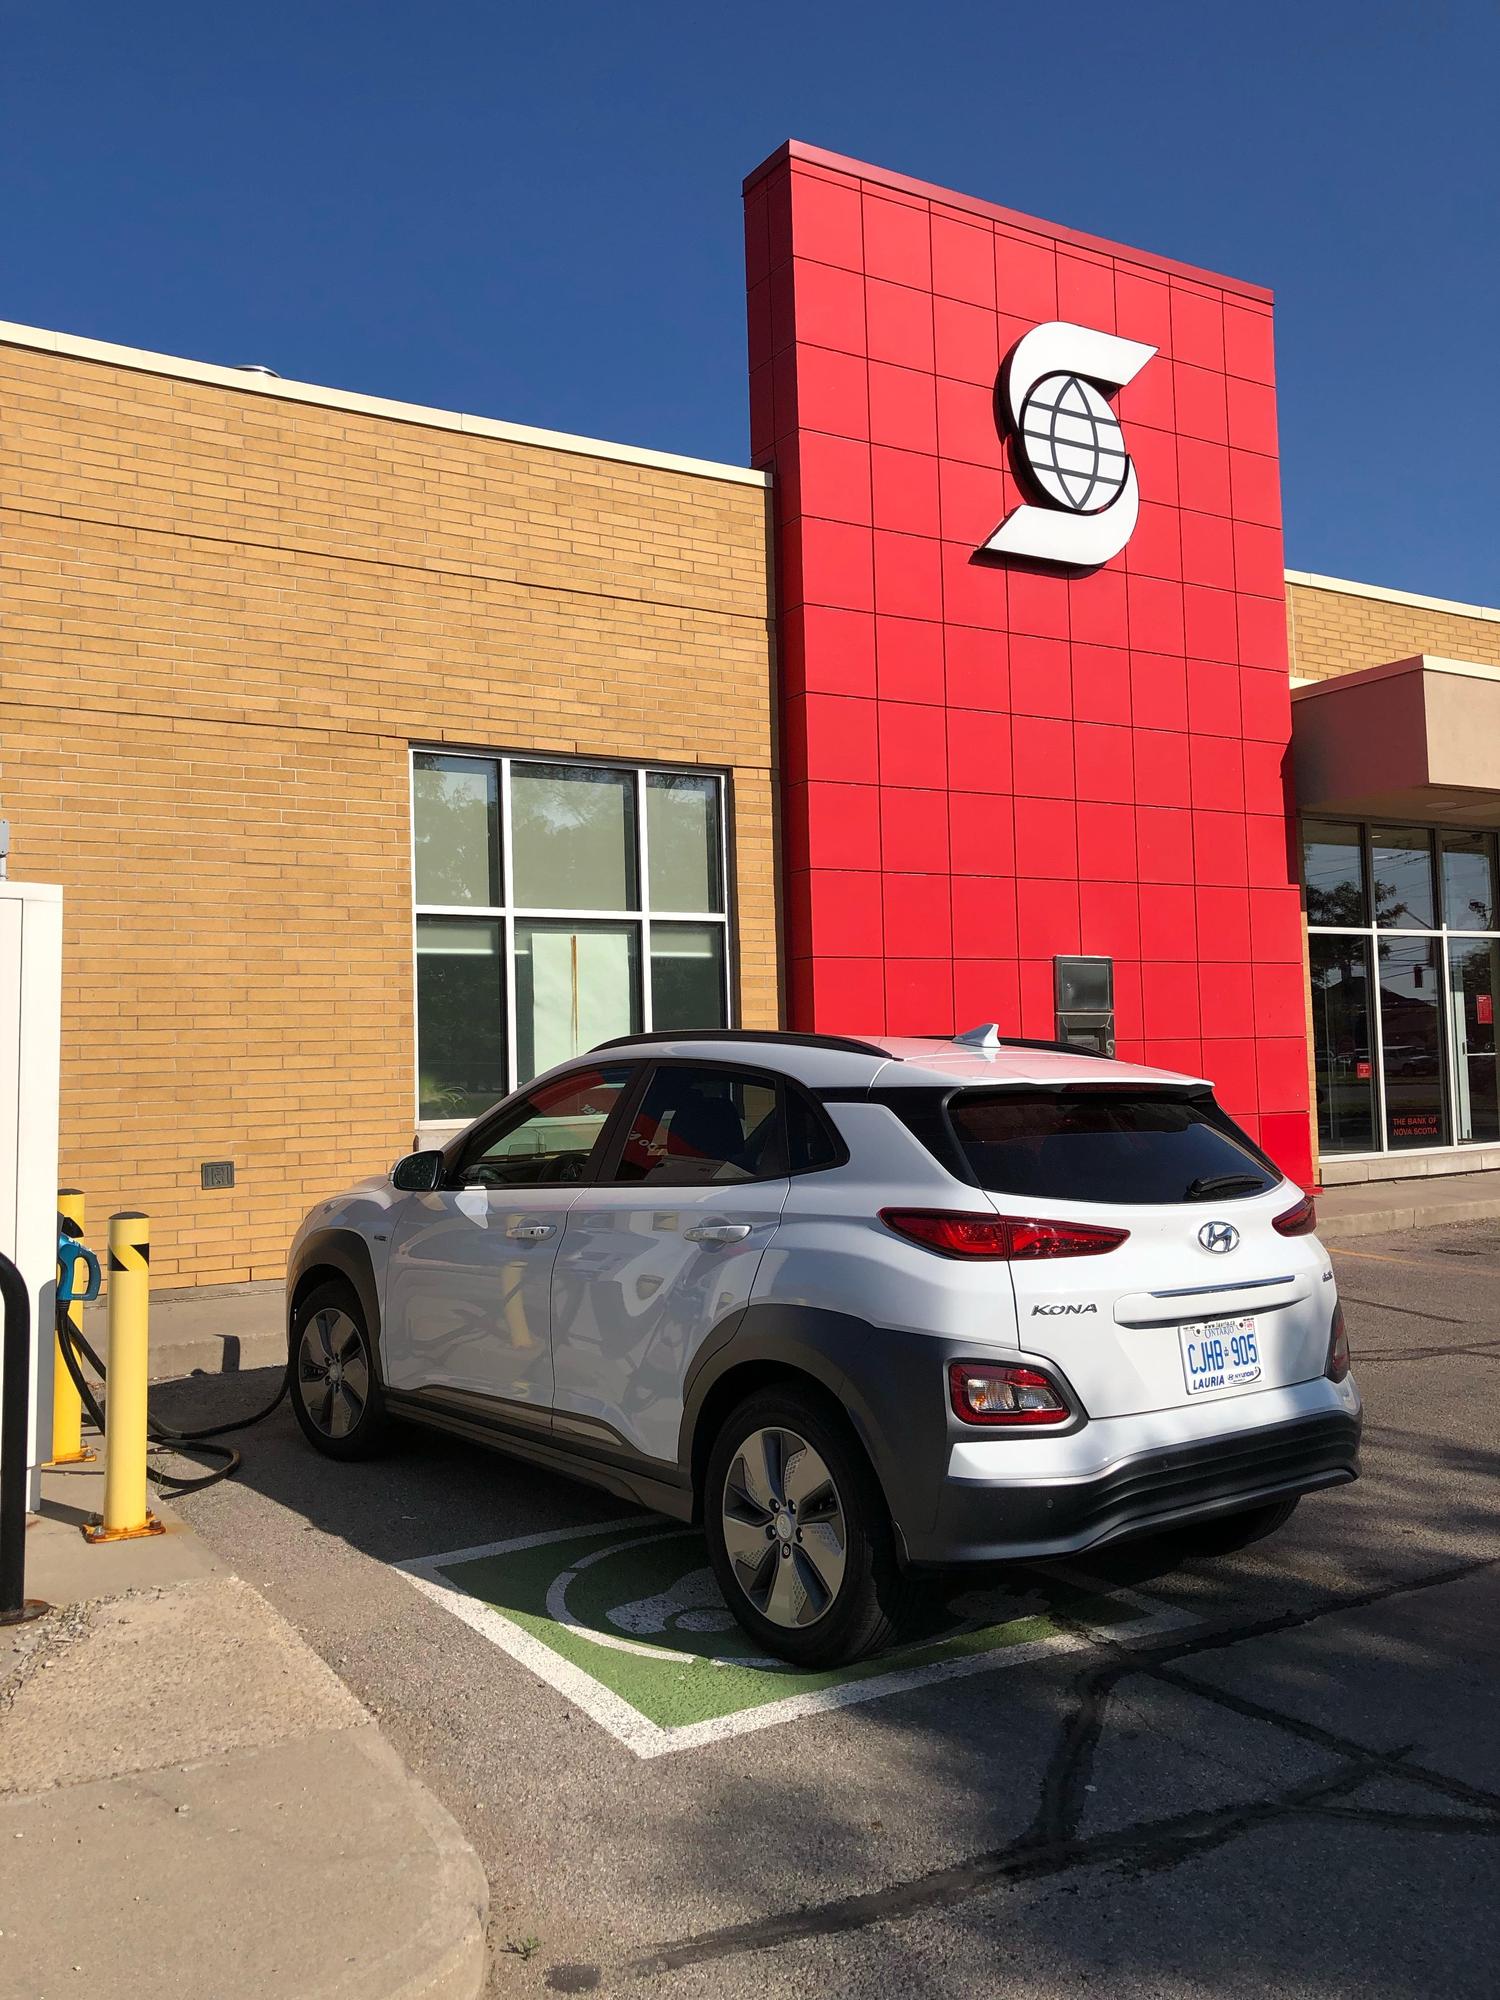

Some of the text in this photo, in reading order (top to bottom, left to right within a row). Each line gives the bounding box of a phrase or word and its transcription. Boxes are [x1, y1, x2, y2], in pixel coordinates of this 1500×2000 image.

[1393, 1118, 1406, 1126] THE
[1407, 1117, 1427, 1125] BANK
[1393, 1127, 1438, 1136] NOVA SCOTIA
[1031, 1303, 1098, 1317] KONA
[1204, 1325, 1235, 1339] ONTARIO
[1187, 1333, 1258, 1375] CJHB 905
[1193, 1374, 1225, 1390] LAURIA
